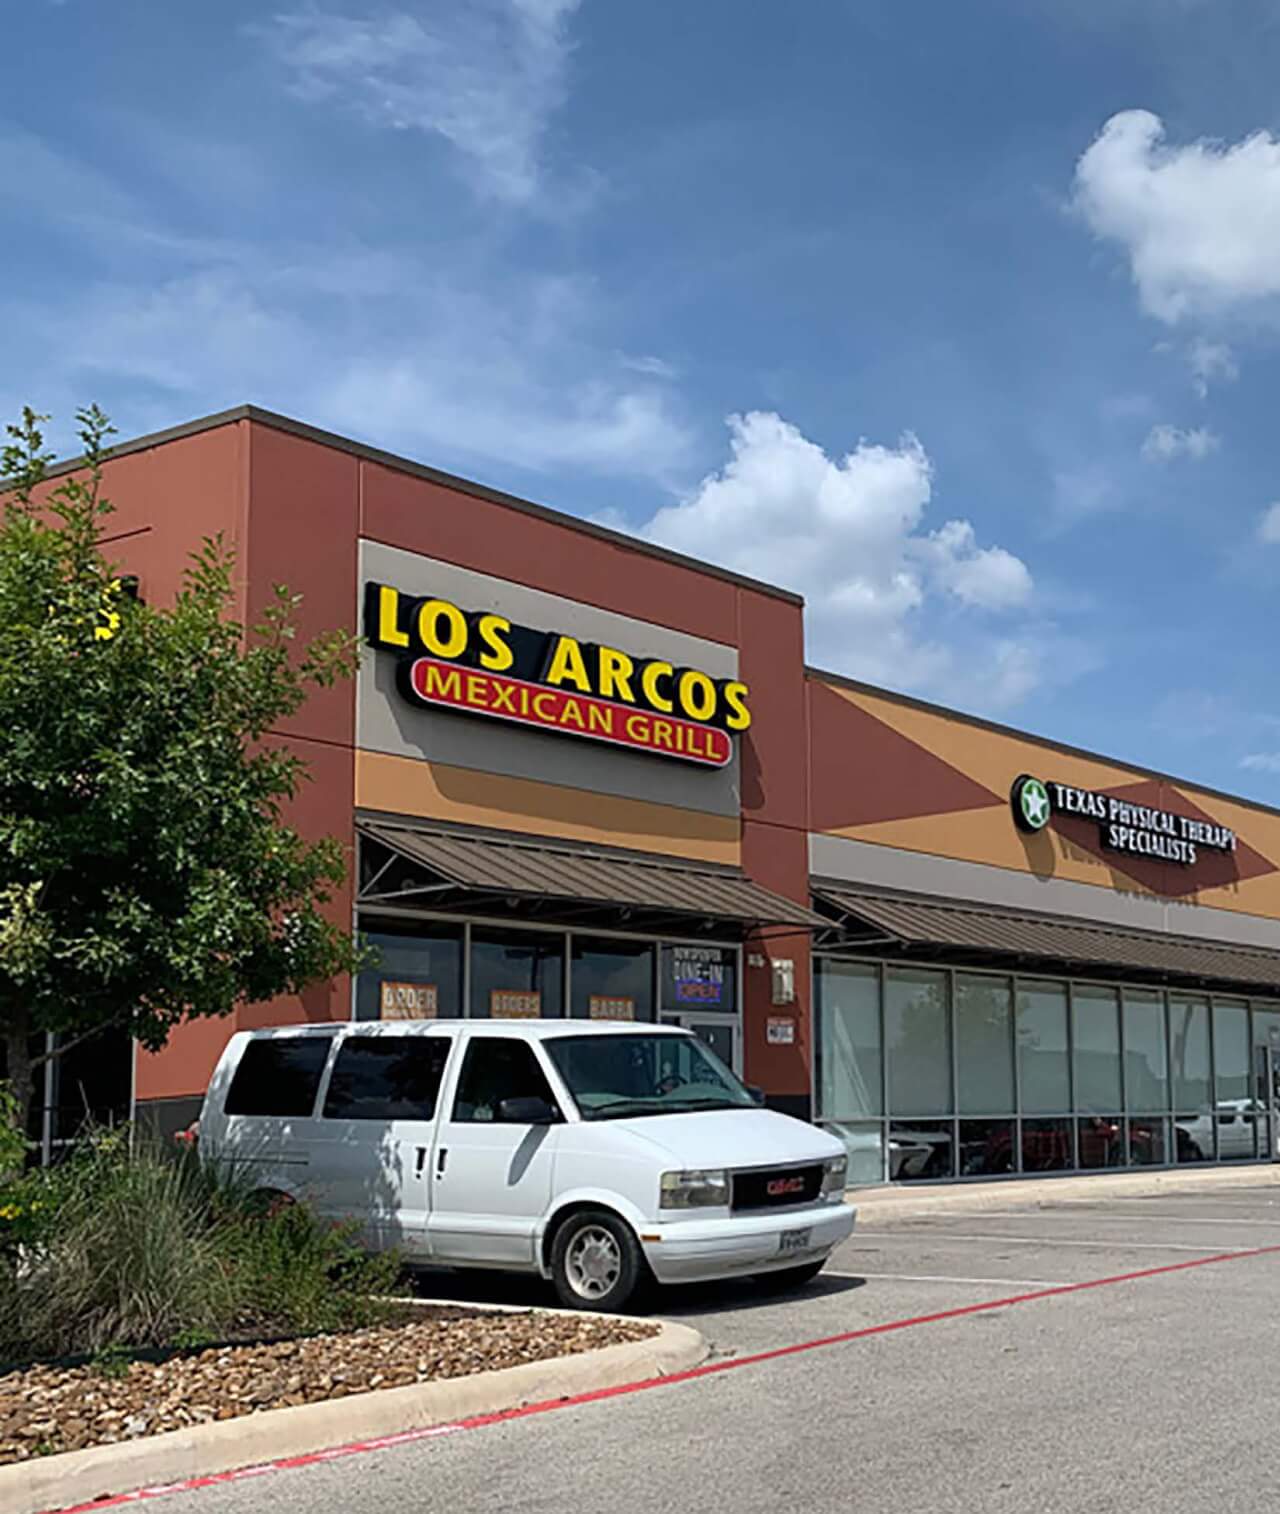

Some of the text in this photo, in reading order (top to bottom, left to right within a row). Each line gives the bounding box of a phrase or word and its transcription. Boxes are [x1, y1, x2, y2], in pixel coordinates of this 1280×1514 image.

[379, 586, 752, 731] LOS ARCOS
[424, 665, 723, 760] MEXICAN GRILL
[1055, 785, 1237, 851] TEXAS PHYSICAL THERAPY
[1109, 824, 1197, 864] SPECIALISTS
[767, 1176, 804, 1196] GMC
